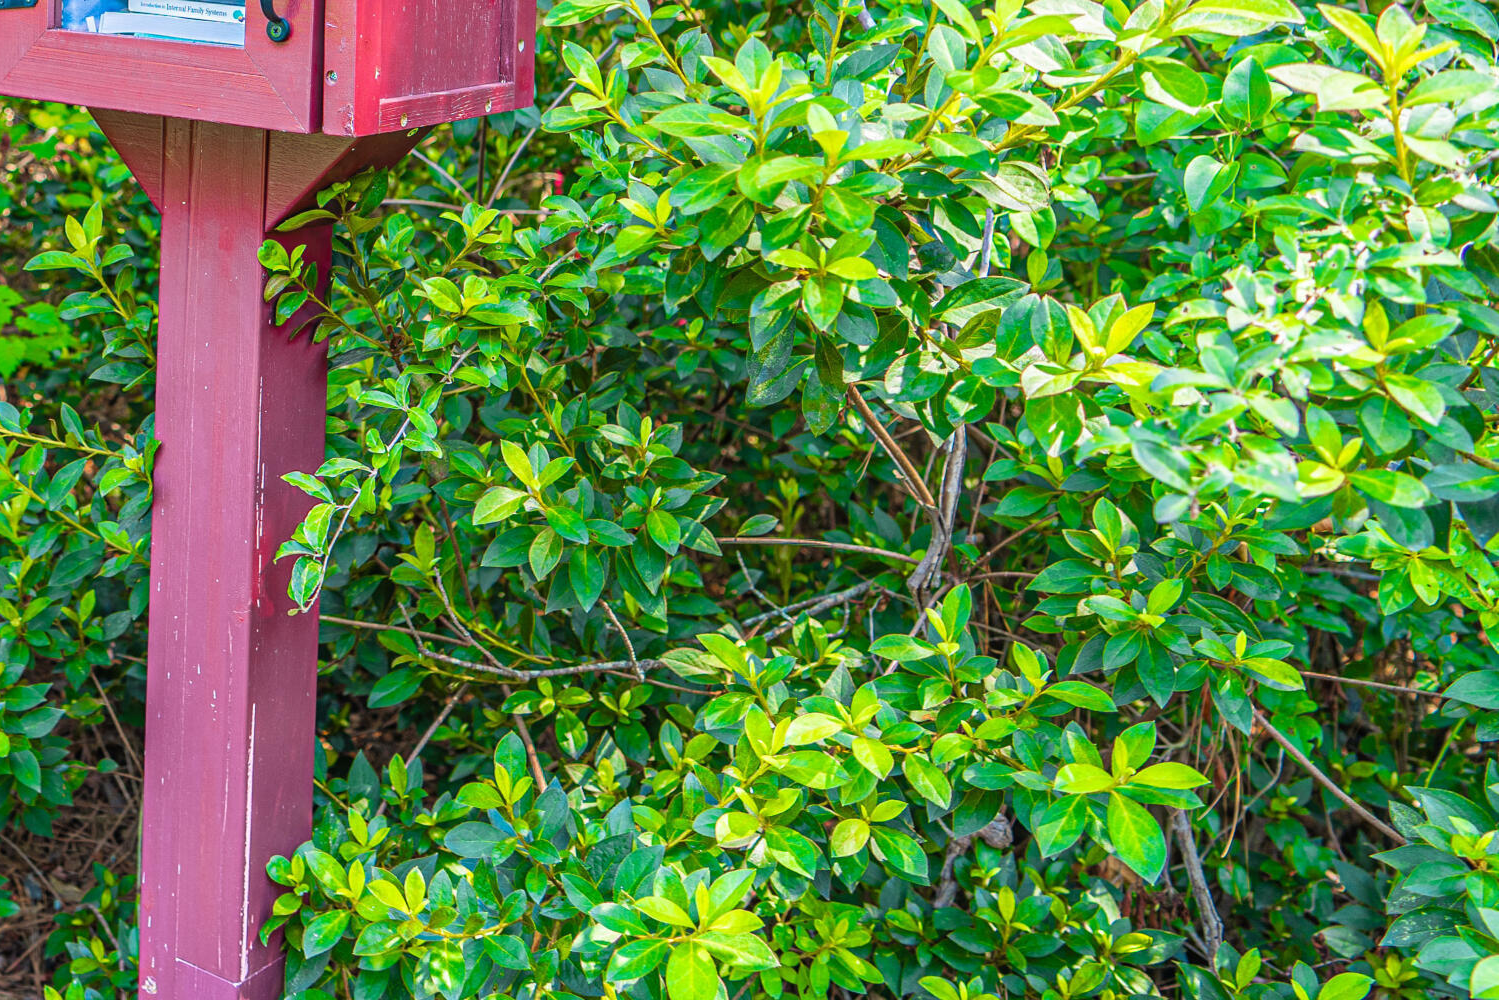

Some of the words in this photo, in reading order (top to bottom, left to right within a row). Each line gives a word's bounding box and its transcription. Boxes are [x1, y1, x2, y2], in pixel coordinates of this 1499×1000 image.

[166, 3, 186, 13] Internal
[187, 6, 204, 15] Family
[205, 8, 228, 17] Systems
